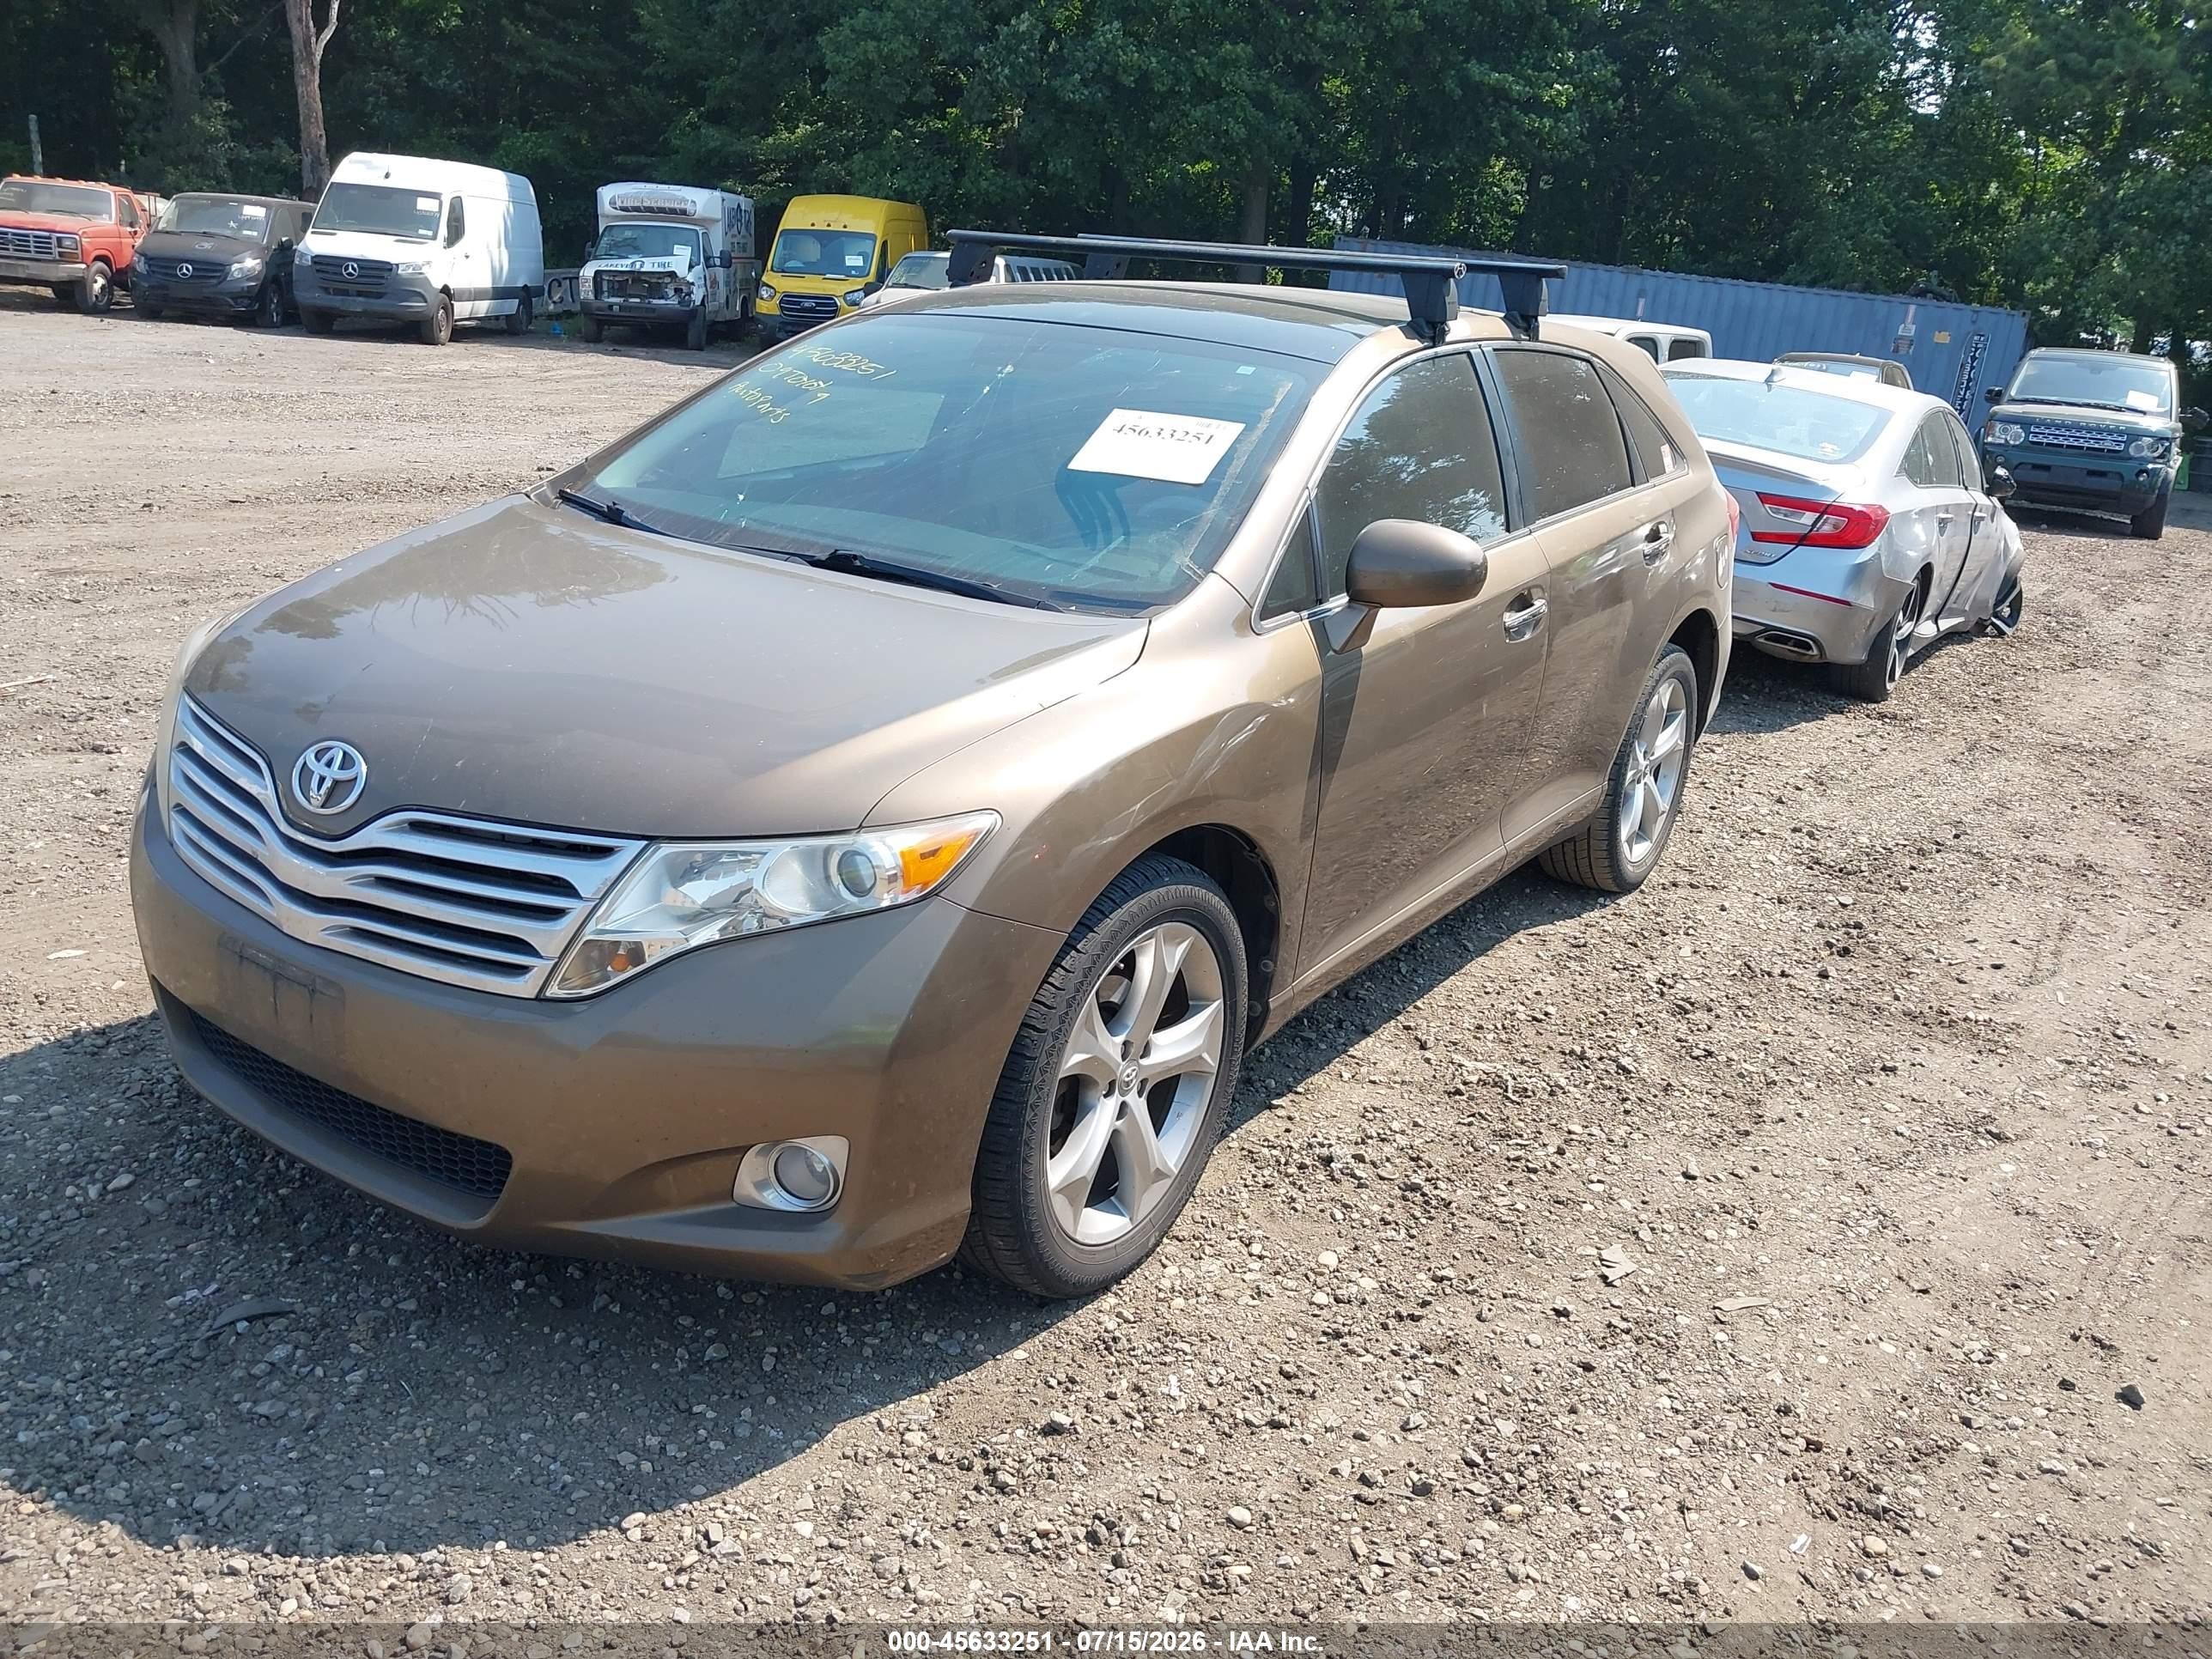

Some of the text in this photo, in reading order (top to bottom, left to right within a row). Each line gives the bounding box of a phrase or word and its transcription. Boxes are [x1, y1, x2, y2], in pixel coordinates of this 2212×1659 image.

[650, 260, 673, 270] TIRE
[2080, 422, 2126, 430] ROVER
[1113, 423, 1214, 445] 45633251
